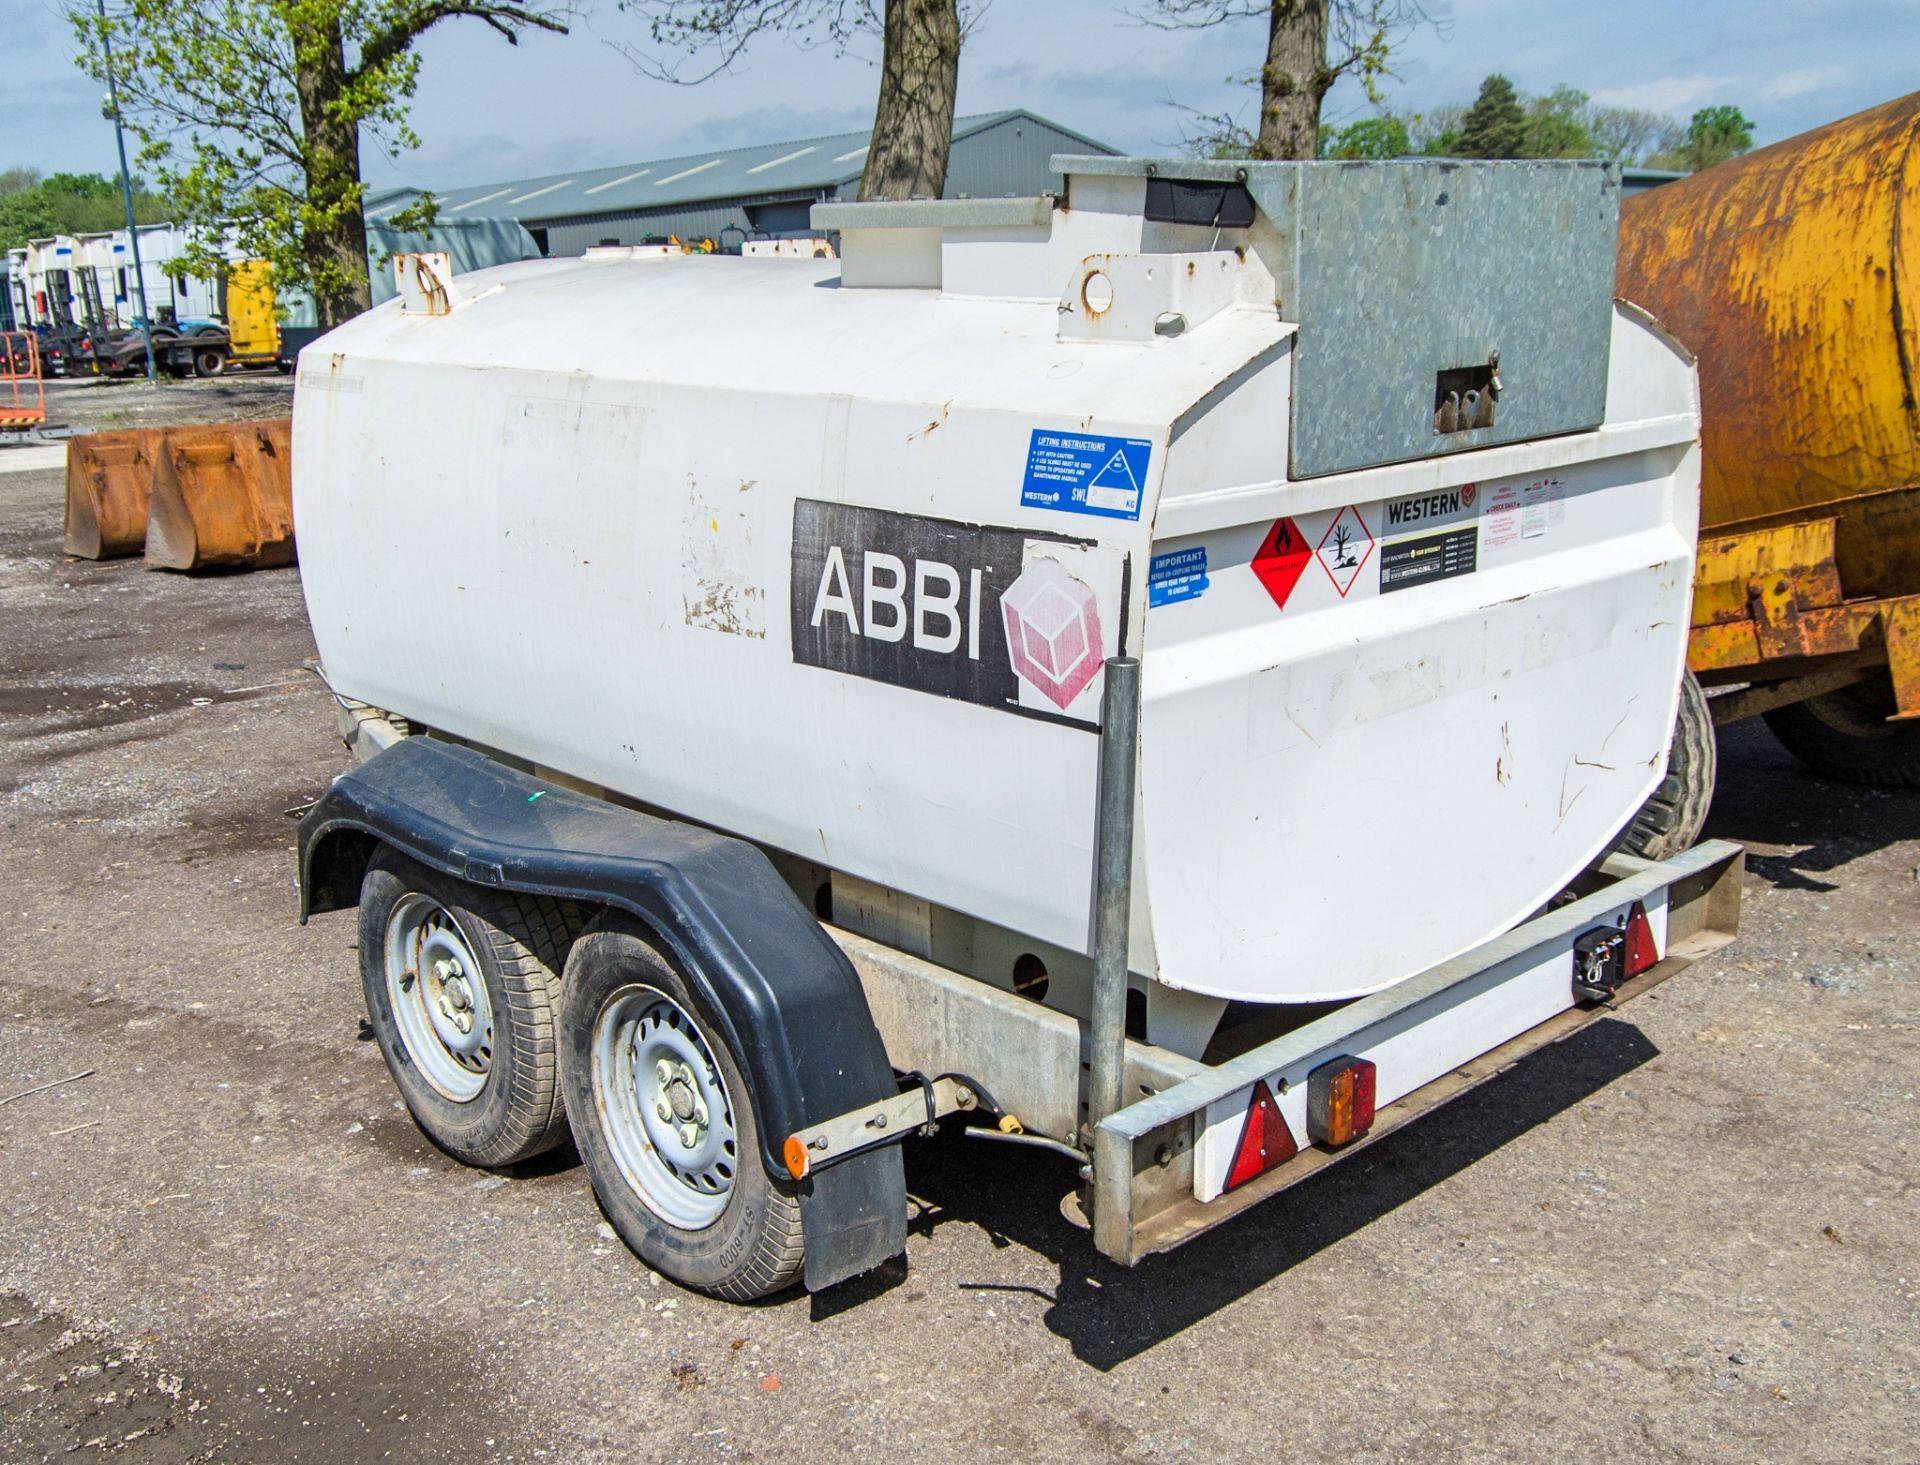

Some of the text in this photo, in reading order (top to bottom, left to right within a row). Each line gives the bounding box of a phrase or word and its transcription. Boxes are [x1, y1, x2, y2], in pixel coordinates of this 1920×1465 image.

[1037, 436, 1105, 451] LIFTING INSTRUCTIONS
[1034, 472, 1060, 480] MAINTENANCE
[1024, 491, 1052, 501] WESTERN
[1072, 487, 1086, 502] SWL
[1126, 500, 1135, 509] KG
[1389, 491, 1459, 524] WESTERN
[1156, 552, 1203, 569] IMPORTANT
[811, 545, 982, 661] ABBI
[720, 1205, 755, 1268] ST-6000
